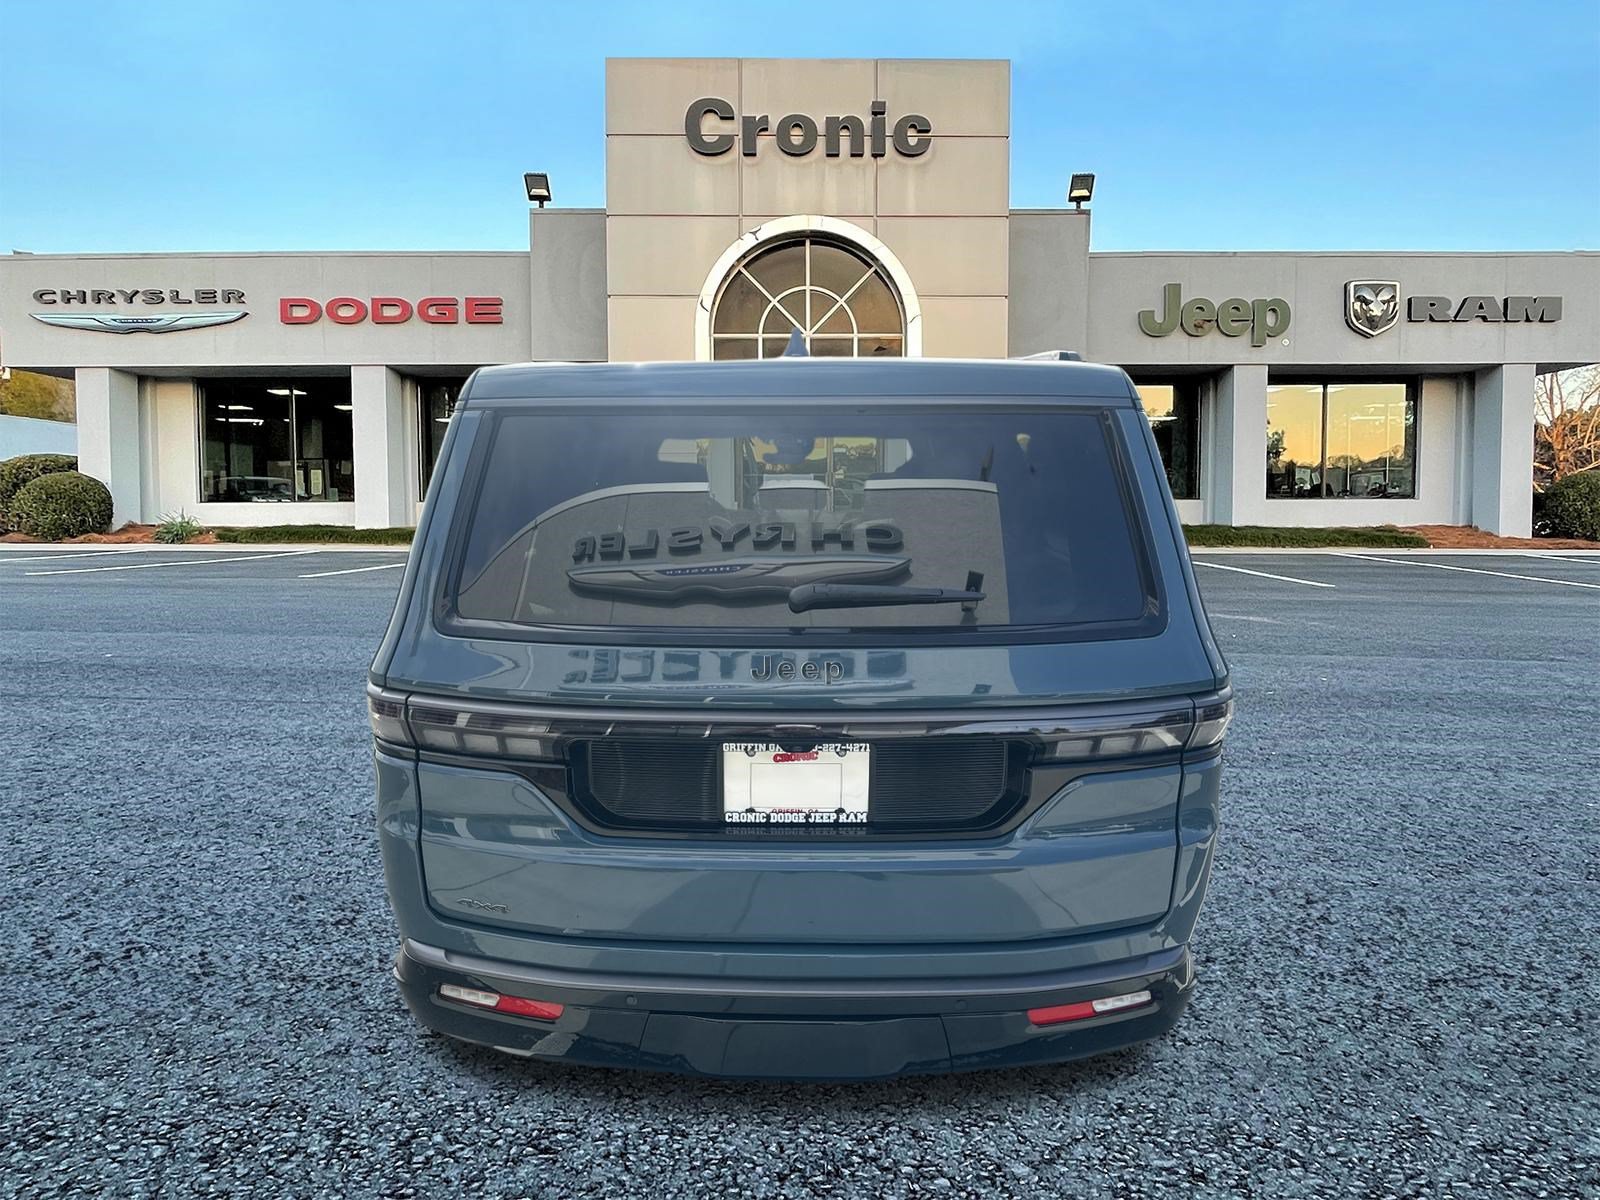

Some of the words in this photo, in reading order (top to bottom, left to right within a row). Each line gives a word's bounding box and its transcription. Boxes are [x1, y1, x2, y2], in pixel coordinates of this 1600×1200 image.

[685, 97, 932, 157] Cronic
[32, 288, 247, 305] CHRYSLER
[1407, 296, 1563, 323] RAM
[279, 297, 503, 325] DODGE
[1137, 283, 1292, 347] Jeep
[750, 654, 845, 685] Jeep
[723, 743, 766, 752] GRIFFIN
[725, 812, 767, 823] CRONIC
[770, 812, 806, 823] DODGE
[808, 812, 837, 823] JEEP
[838, 812, 867, 823] RAM
